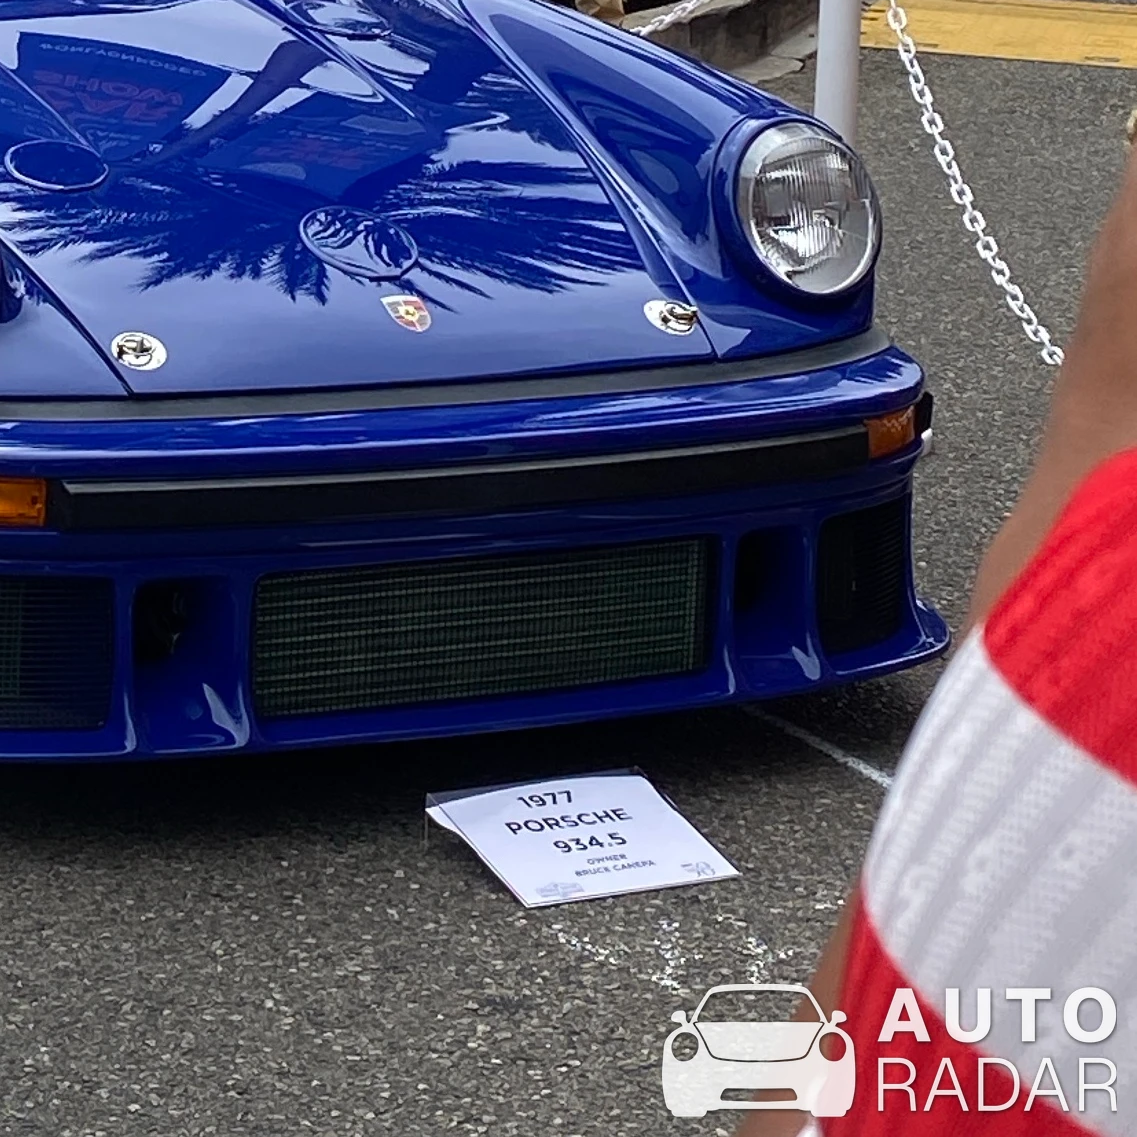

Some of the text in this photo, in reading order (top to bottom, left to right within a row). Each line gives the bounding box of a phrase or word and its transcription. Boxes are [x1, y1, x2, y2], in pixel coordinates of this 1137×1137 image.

[516, 789, 574, 809] 1977
[504, 808, 634, 835] PORSCHE
[552, 832, 628, 854] 934.5
[586, 853, 628, 865] OWNER
